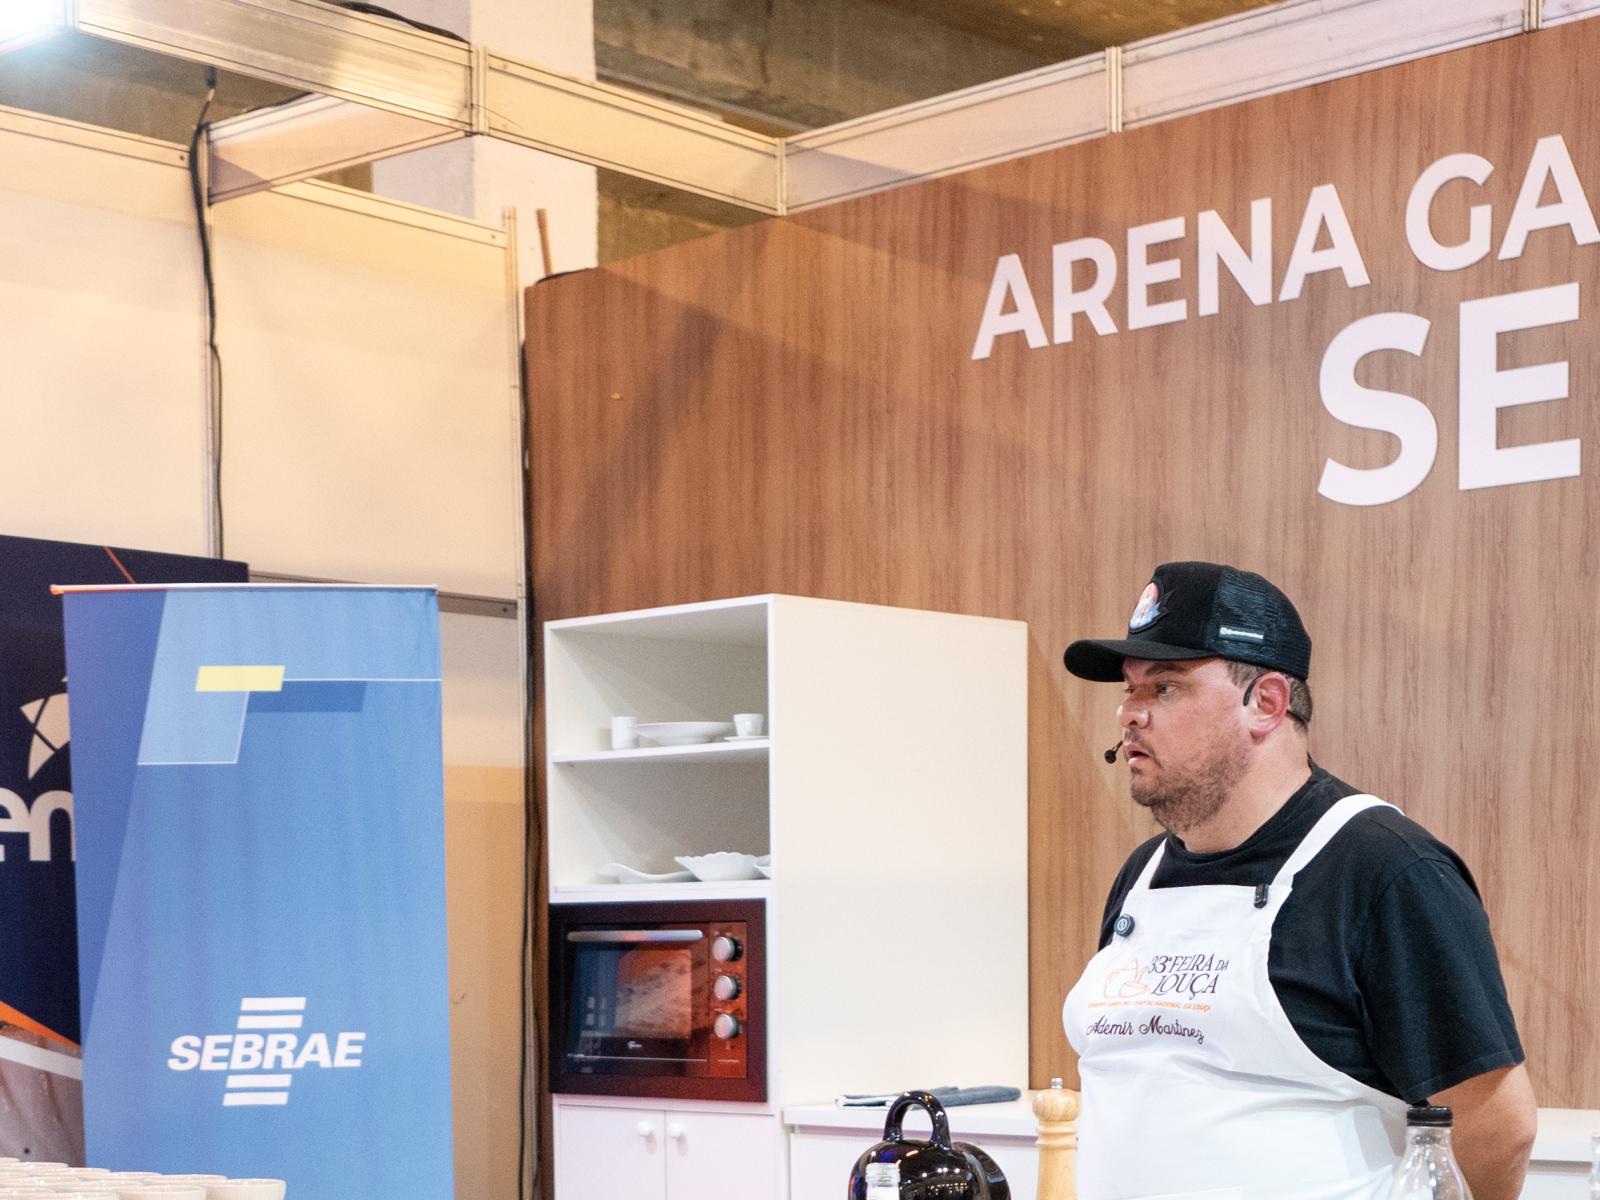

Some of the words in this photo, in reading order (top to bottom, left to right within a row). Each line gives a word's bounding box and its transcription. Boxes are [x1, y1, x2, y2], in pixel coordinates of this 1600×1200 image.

[971, 183, 1371, 360] ARENA
[1405, 134, 1600, 271] GA
[1317, 282, 1582, 506] SE
[1168, 953, 1215, 973] FEIRA
[1215, 959, 1230, 971] DA
[1151, 973, 1219, 1000] LOUÇA
[1086, 1014, 1134, 1036] Ademir
[1139, 1014, 1205, 1045] Martinez
[167, 1032, 367, 1071] SEBRAE
